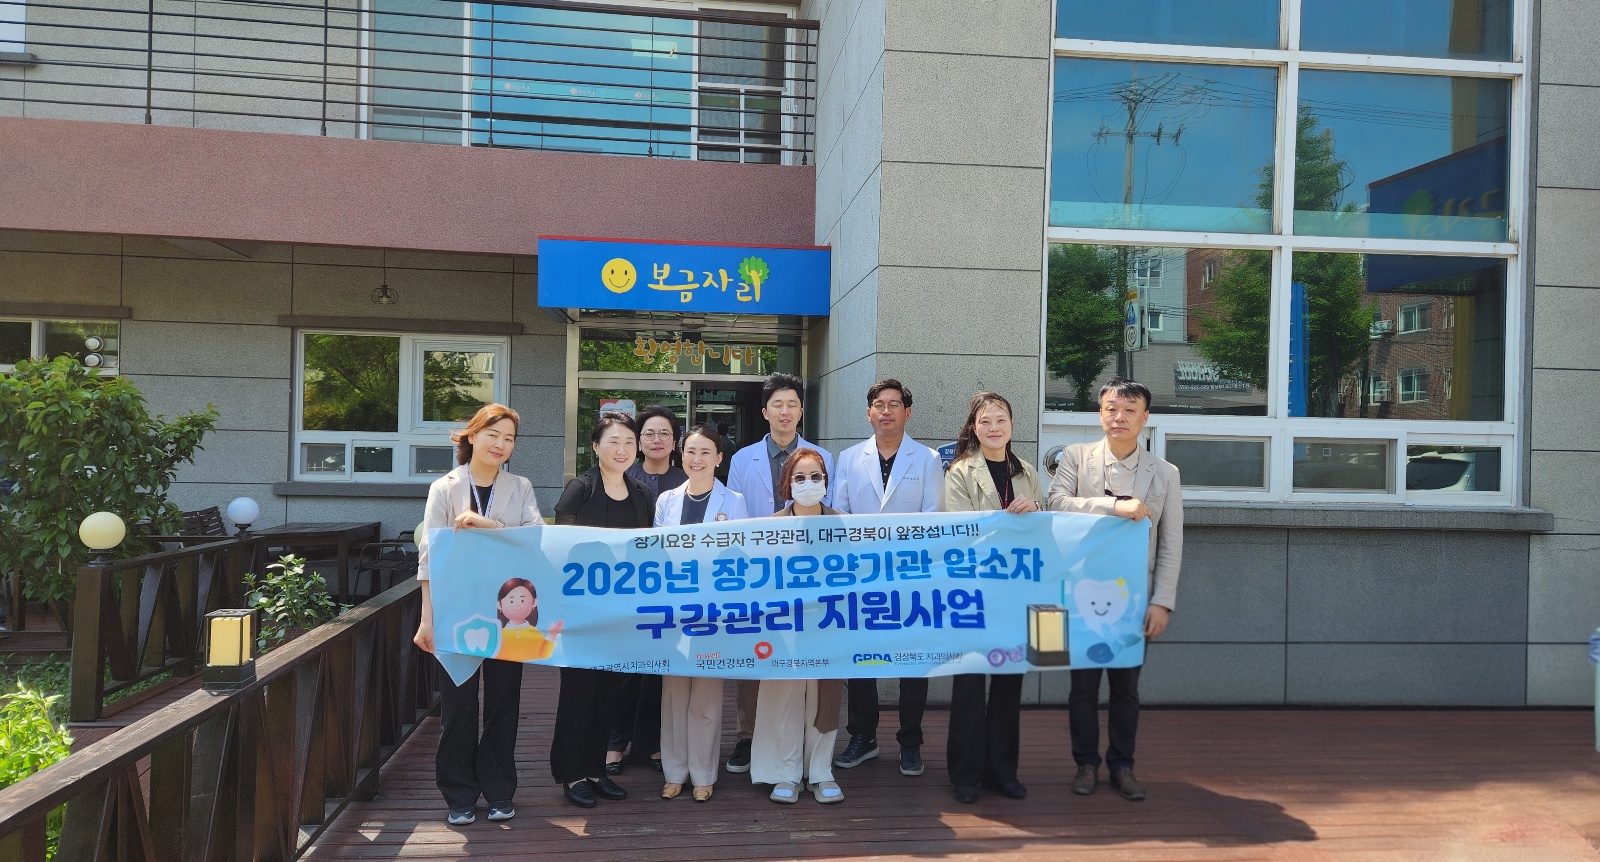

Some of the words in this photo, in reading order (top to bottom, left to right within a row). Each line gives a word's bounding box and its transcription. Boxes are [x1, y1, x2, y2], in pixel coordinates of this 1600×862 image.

[647, 263, 761, 303] 보금자리
[633, 336, 756, 366] 환영합니다
[633, 533, 697, 550] 장기요양
[700, 531, 746, 548] 수급자
[750, 529, 814, 546] 구강관리,
[818, 526, 892, 543] 대구경북이
[896, 523, 979, 541] 앞장섭니다!!
[562, 559, 700, 596] 2026년
[712, 548, 933, 592] 장기요양기관
[943, 547, 1044, 582] 입소자
[635, 597, 805, 640] 구강관리
[817, 588, 986, 631] 지원사업
[696, 658, 755, 671] 국민건강보험
[771, 659, 830, 668] 대구경북지역본부
[894, 652, 924, 662] 경상북도
